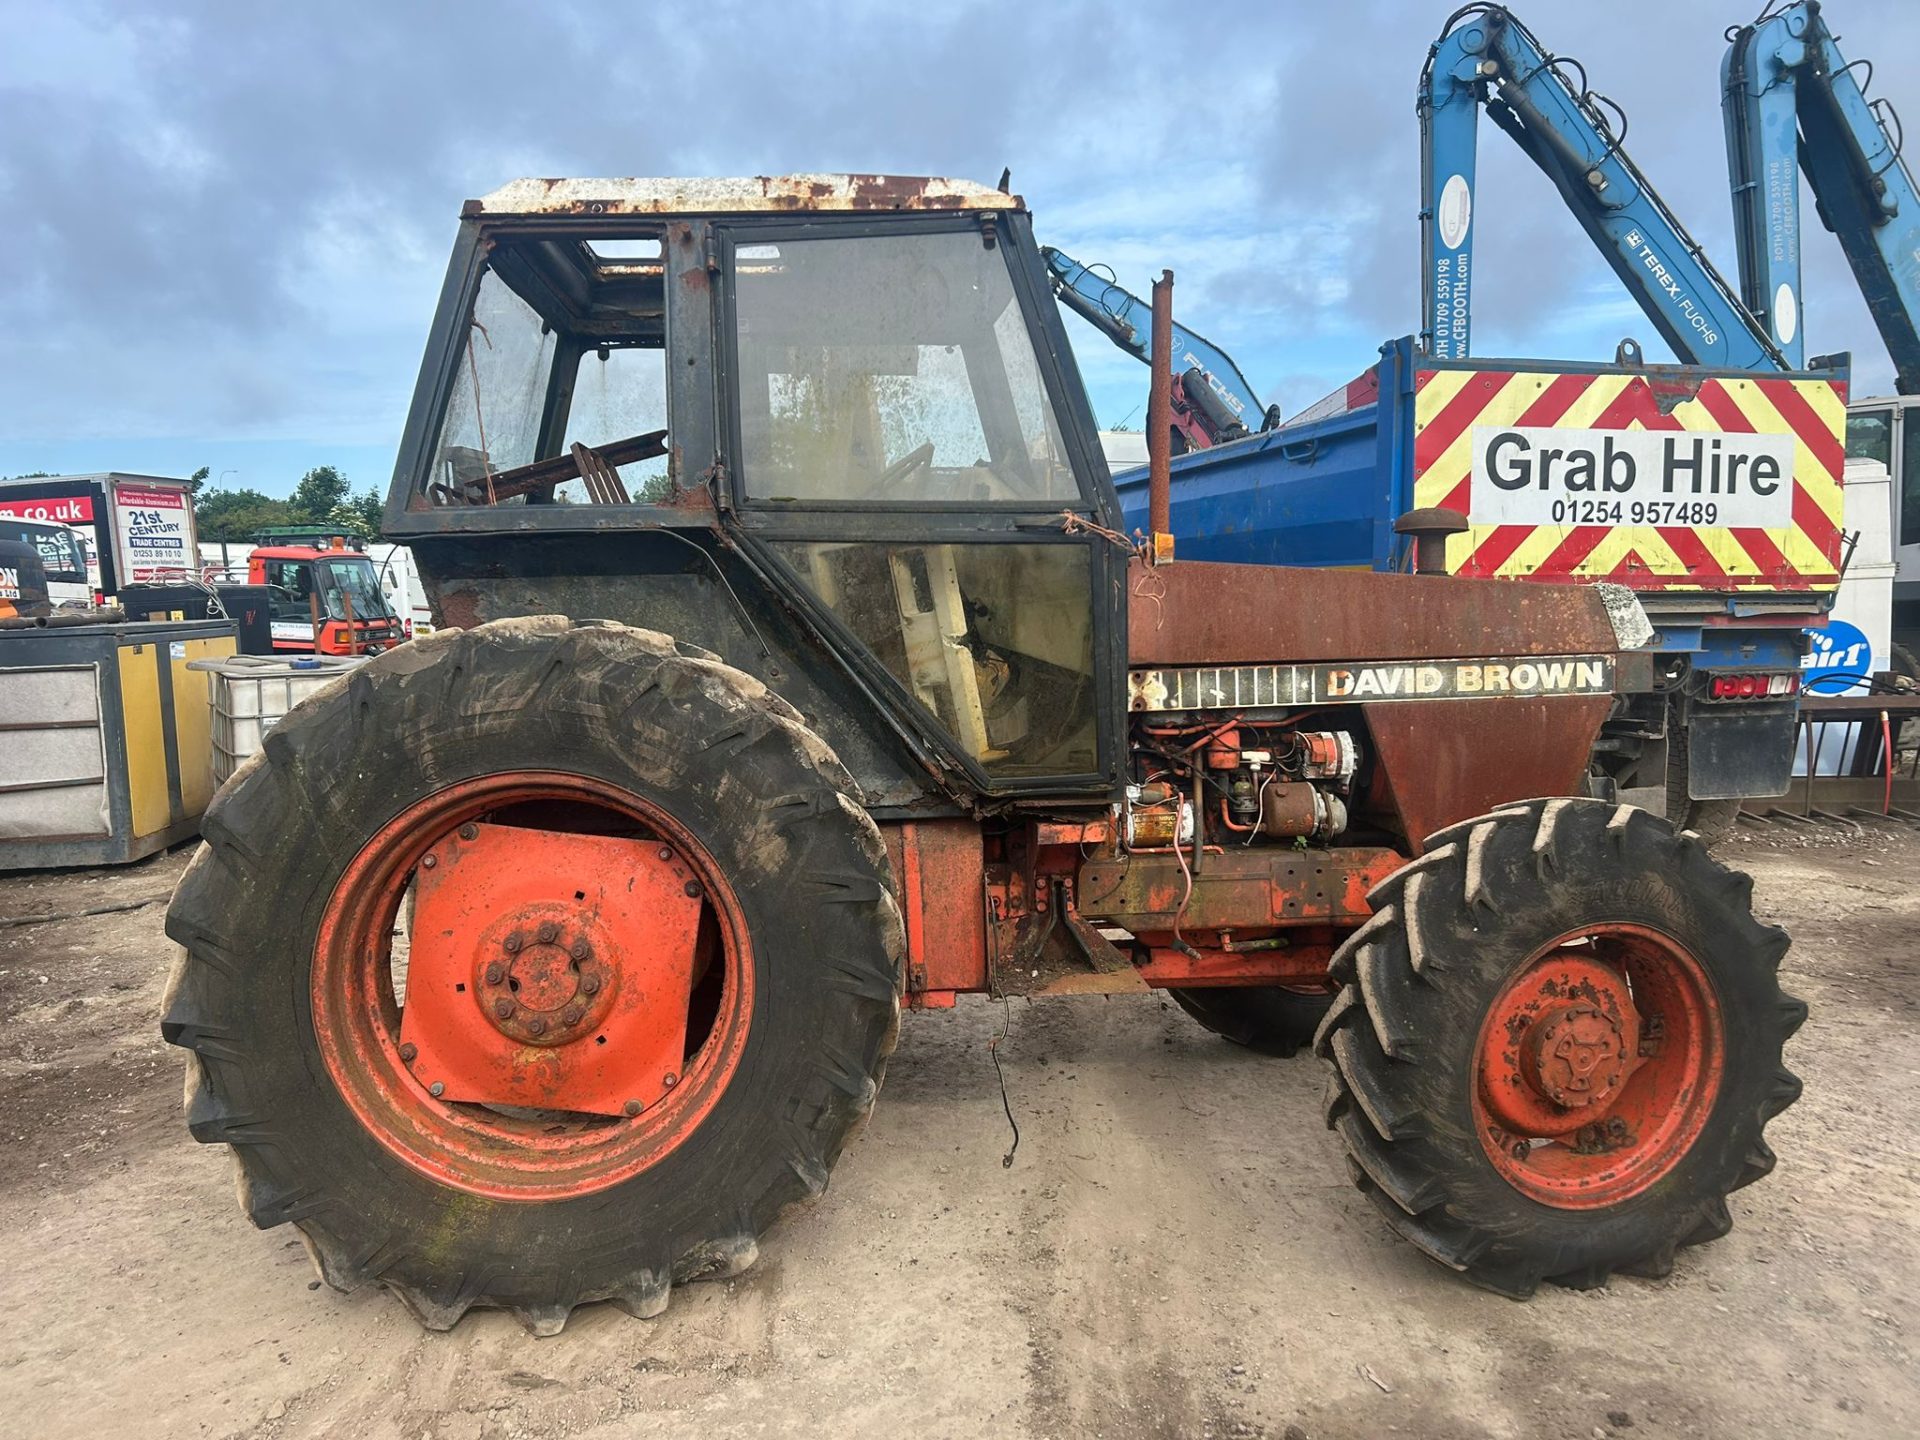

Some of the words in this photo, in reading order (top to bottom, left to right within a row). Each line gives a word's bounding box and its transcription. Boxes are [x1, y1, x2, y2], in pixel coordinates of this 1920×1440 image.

[1437, 258, 1450, 299] 559198
[1639, 245, 1681, 298] TEREX
[1678, 299, 1718, 345] FUCHS
[1437, 303, 1449, 336] 01709
[1485, 432, 1636, 493] Grab
[1662, 437, 1780, 496] Hire
[128, 510, 163, 525] 21st
[1552, 500, 1622, 523] 01254
[1631, 502, 1718, 524] 957489
[128, 523, 180, 536] CENTURY
[131, 538, 152, 546] TRADE
[153, 538, 180, 547] CENTRES
[133, 549, 153, 557] 01253
[1327, 667, 1443, 696] DAVID
[1456, 661, 1602, 692] BROWN
